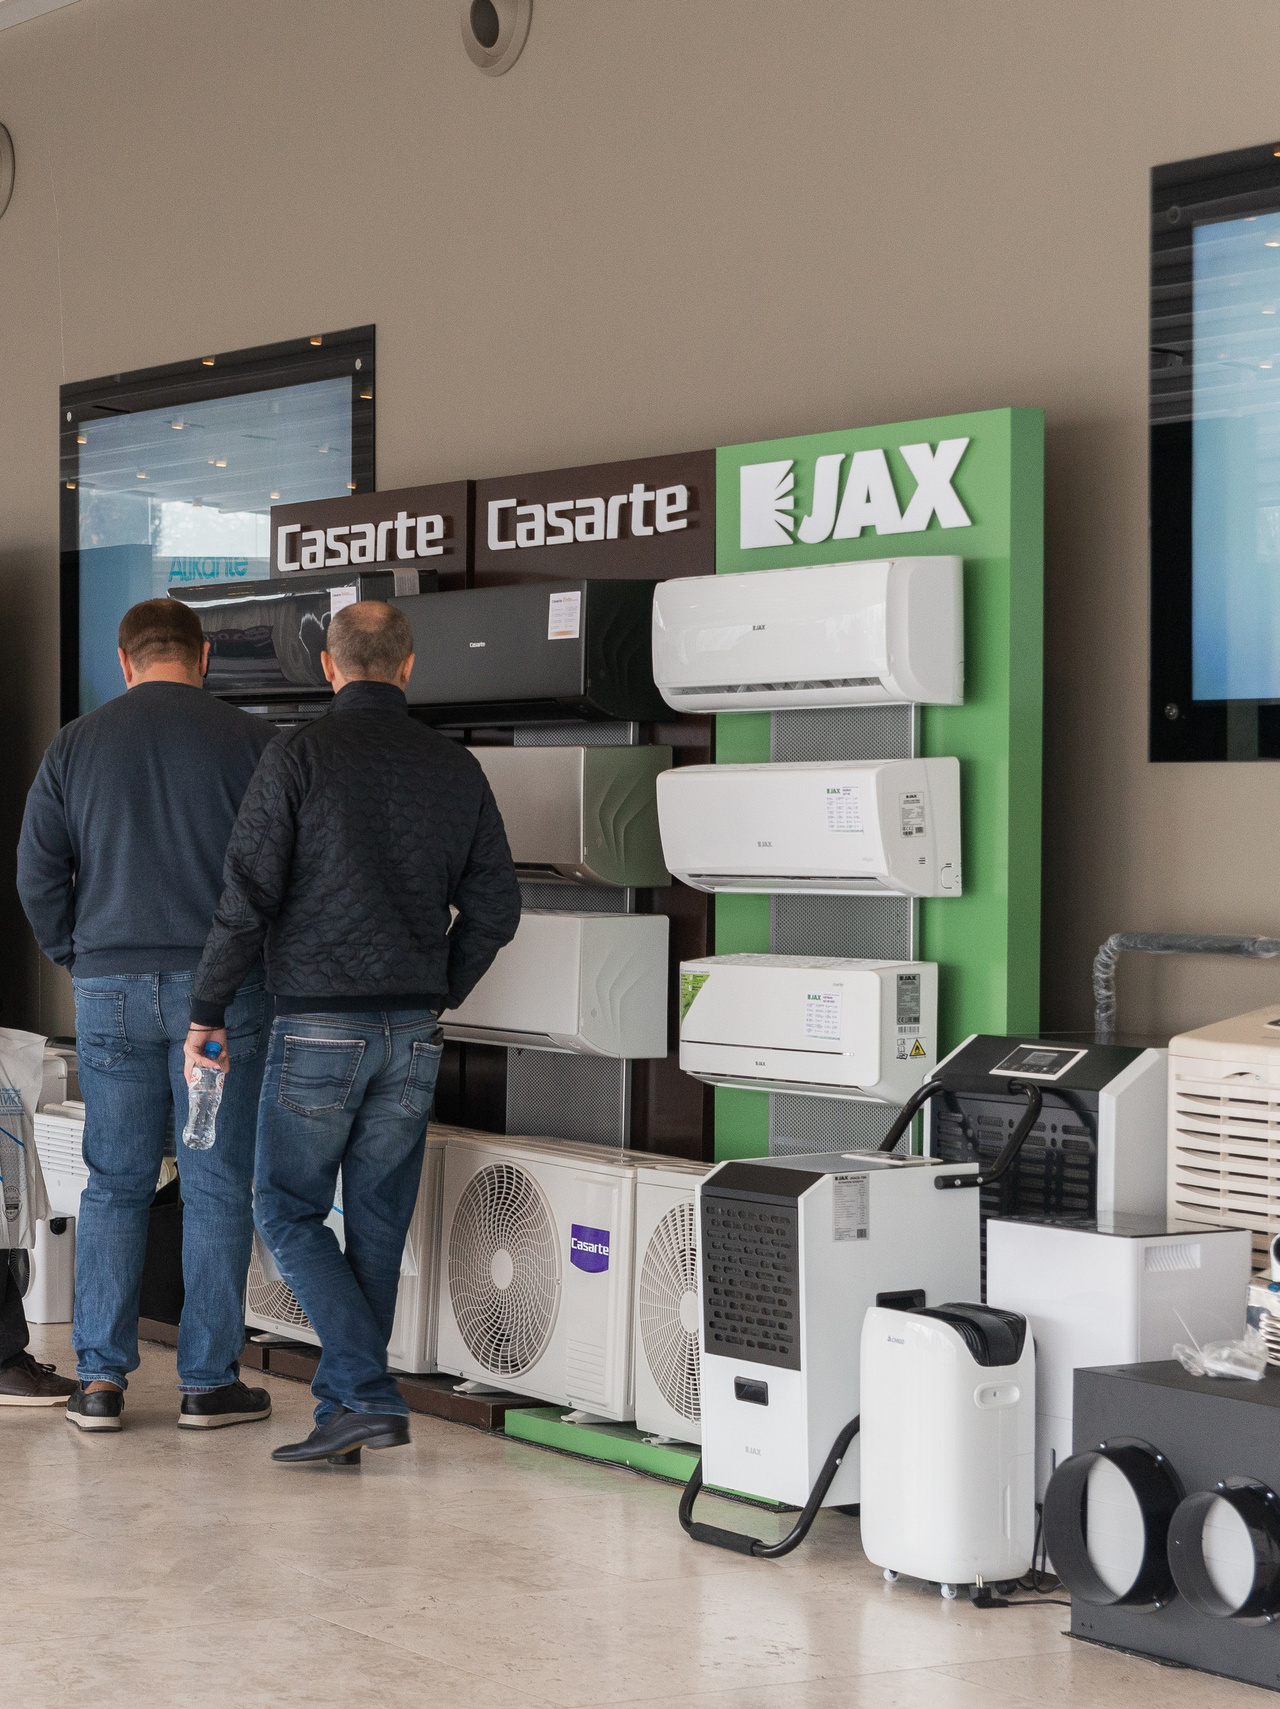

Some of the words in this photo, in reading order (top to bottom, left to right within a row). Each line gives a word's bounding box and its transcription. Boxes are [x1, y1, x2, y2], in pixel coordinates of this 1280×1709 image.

[277, 511, 444, 572] Casarte
[487, 483, 688, 551] Casarte
[571, 1237, 609, 1256] Casarte
